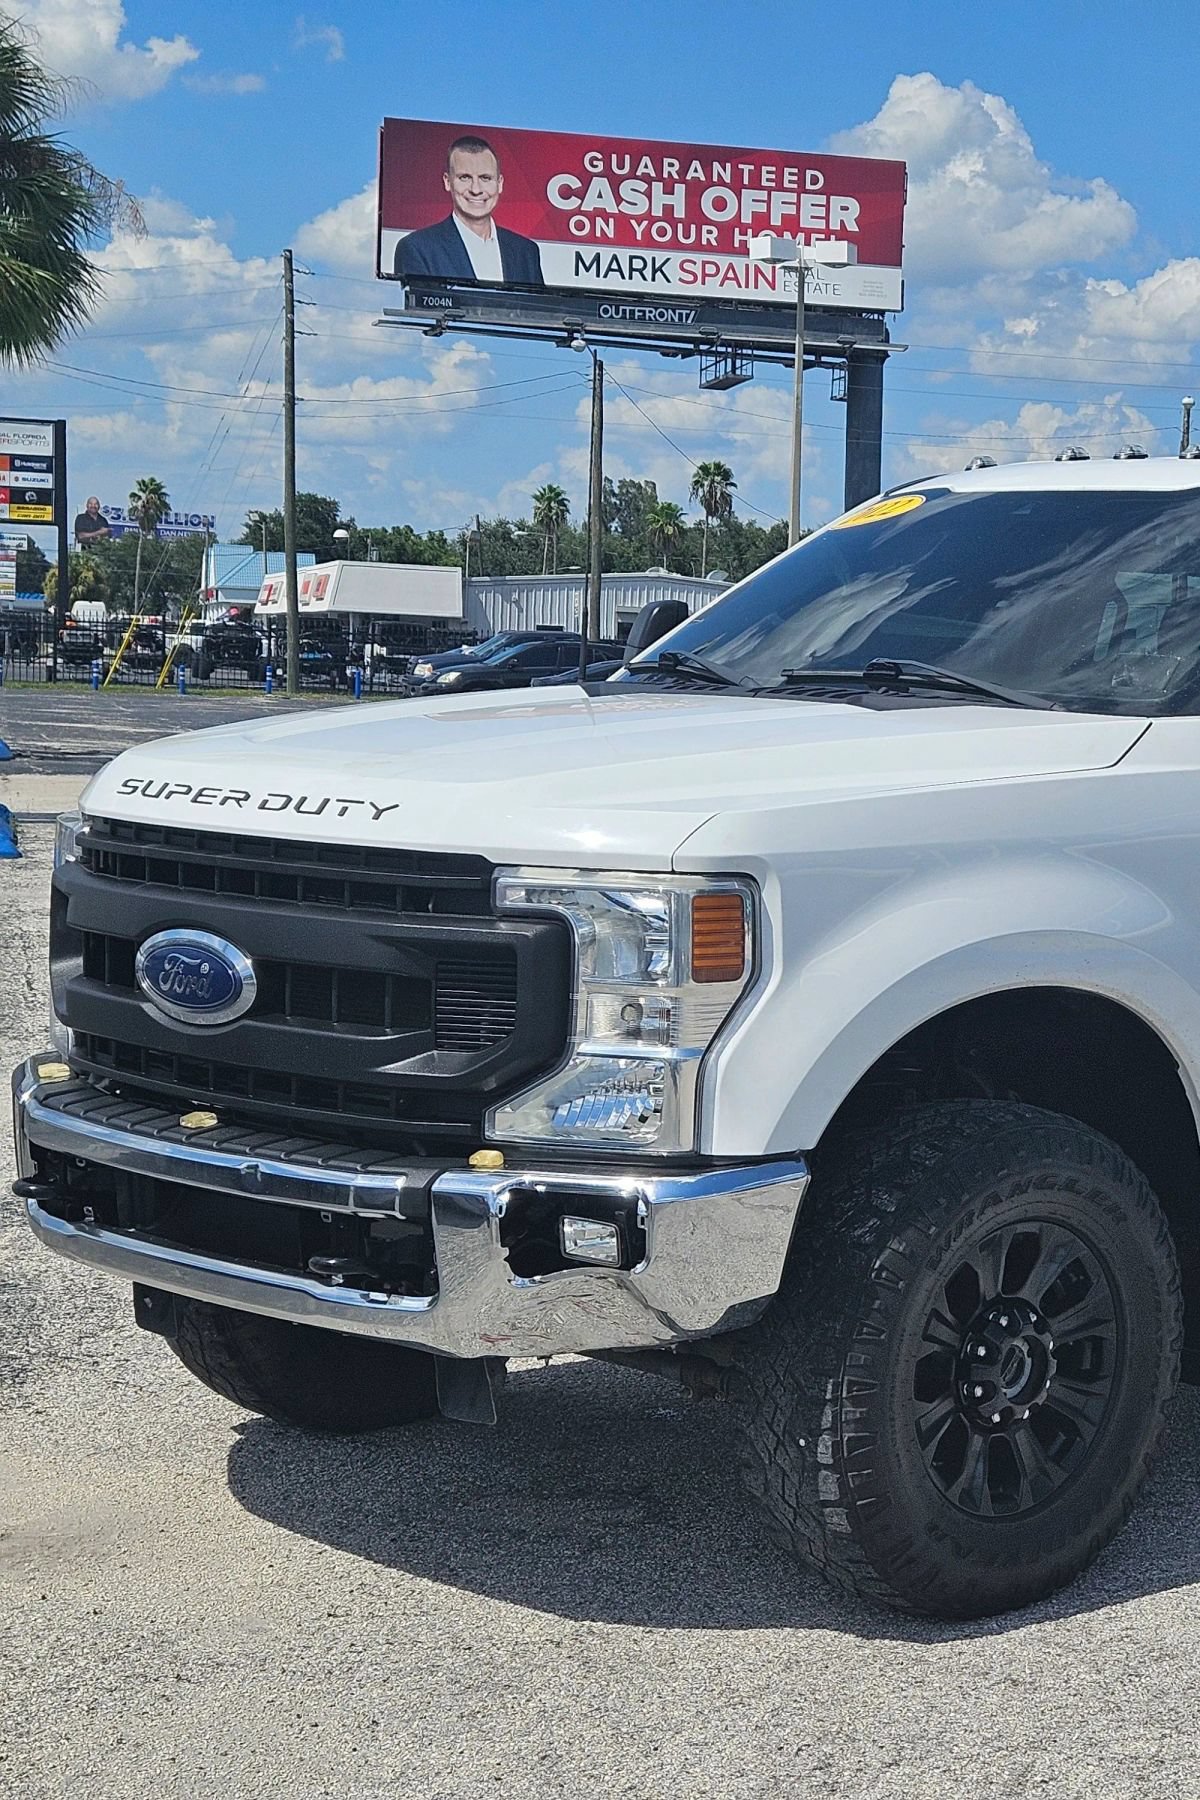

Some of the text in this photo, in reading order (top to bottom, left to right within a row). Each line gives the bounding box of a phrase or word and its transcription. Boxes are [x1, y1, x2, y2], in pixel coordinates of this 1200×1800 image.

[583, 151, 825, 190] GUARANTEED
[547, 173, 861, 232] CASH OFFER
[569, 215, 615, 238] ON
[630, 219, 719, 246] YOUR
[574, 250, 777, 291] MARK SPAIN
[422, 297, 453, 307] 7004N
[116, 778, 400, 821] SUPER DUTY
[159, 953, 214, 999] Ford
[925, 1172, 1128, 1270] WRANGLER
